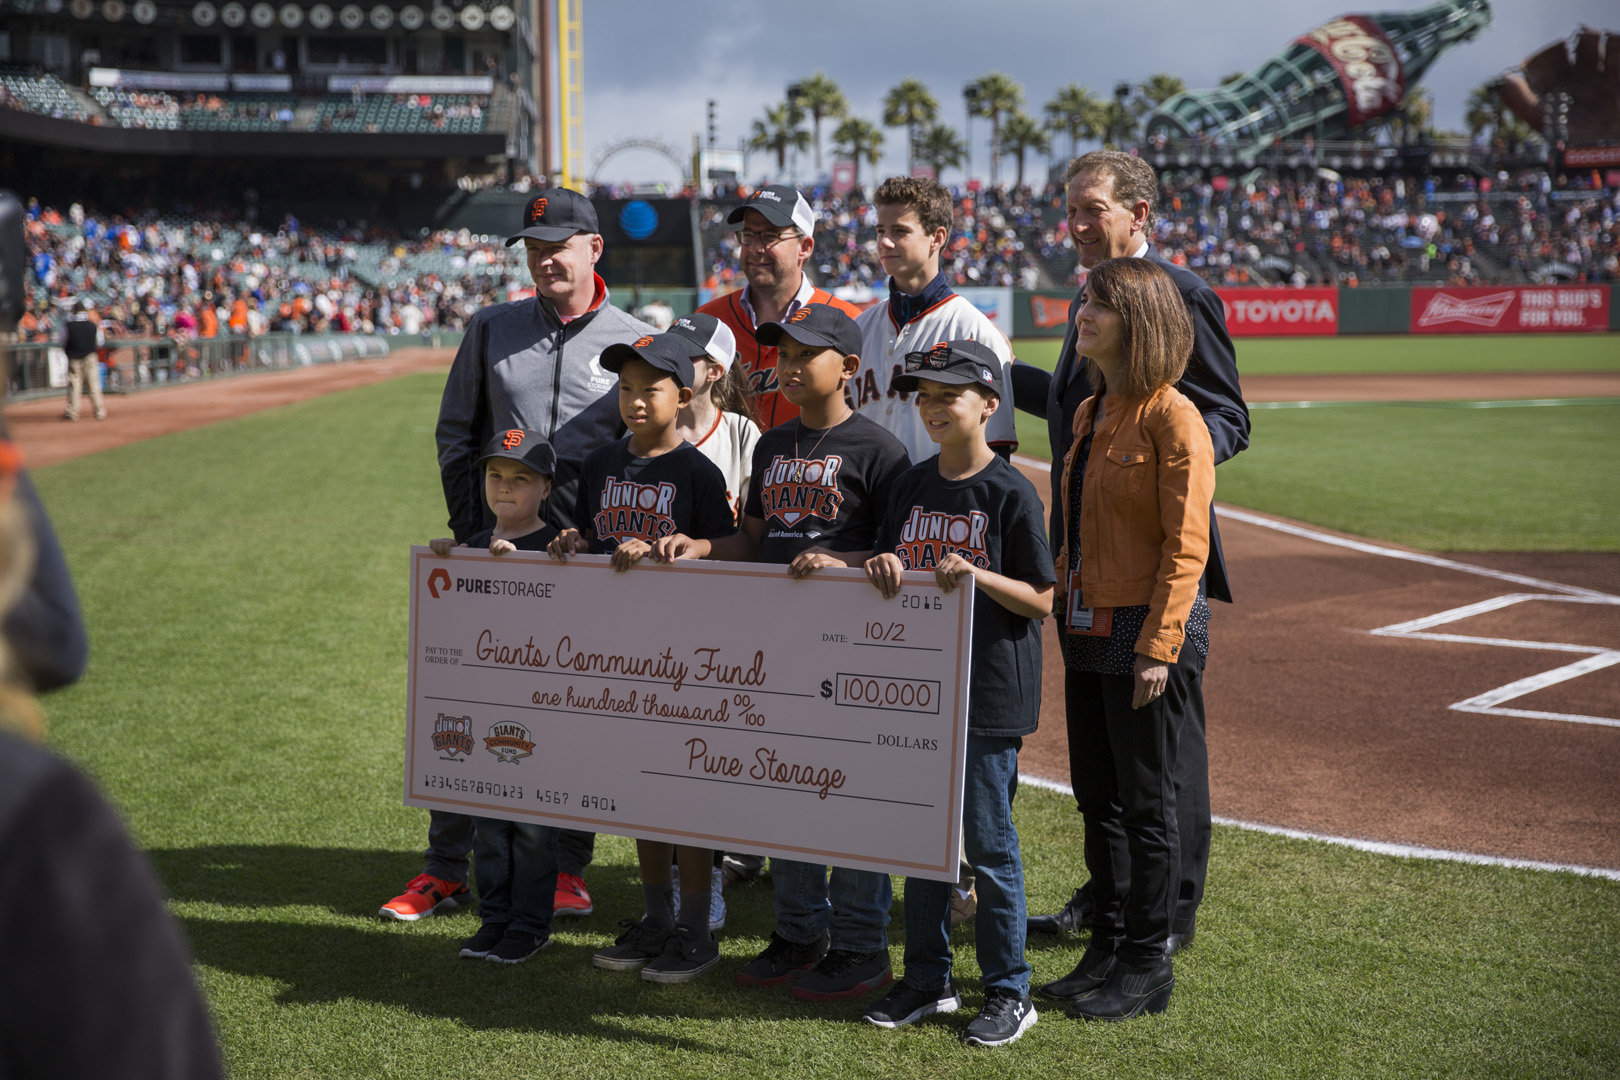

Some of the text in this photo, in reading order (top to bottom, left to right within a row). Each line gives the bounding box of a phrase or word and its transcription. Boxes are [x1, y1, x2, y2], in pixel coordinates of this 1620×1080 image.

[531, 198, 548, 221] SF
[1520, 289, 1555, 309] THIS
[1233, 300, 1336, 323] TOYOTA
[1519, 308, 1551, 327] FOR
[590, 376, 610, 386] PURE
[503, 429, 525, 450] SF
[764, 457, 839, 488] JUNIOR
[602, 480, 673, 515] JUNIOR
[762, 486, 839, 517] GIANTS
[598, 510, 673, 540] GIANTS
[903, 509, 985, 550] JUNIOR
[902, 594, 942, 610] 2016
[822, 621, 906, 643] DATE: 10/2
[425, 646, 463, 657] PAY TO THE
[425, 655, 459, 666] ORDER OF
[476, 629, 766, 692] Giants Community Fund
[844, 678, 931, 708] 100,000
[532, 689, 562, 706] one
[566, 686, 639, 714] hundred
[643, 693, 730, 723] thousand
[437, 716, 470, 736] JUNIOR
[494, 725, 526, 740] GIANTS
[434, 733, 473, 752] GIANTS
[489, 738, 530, 750] COMMUNITY
[501, 747, 517, 755] FUND
[877, 733, 938, 751] DOLLARS
[685, 737, 846, 800] Pure Storage
[425, 774, 616, 812] 1234567890123 4567 8901
